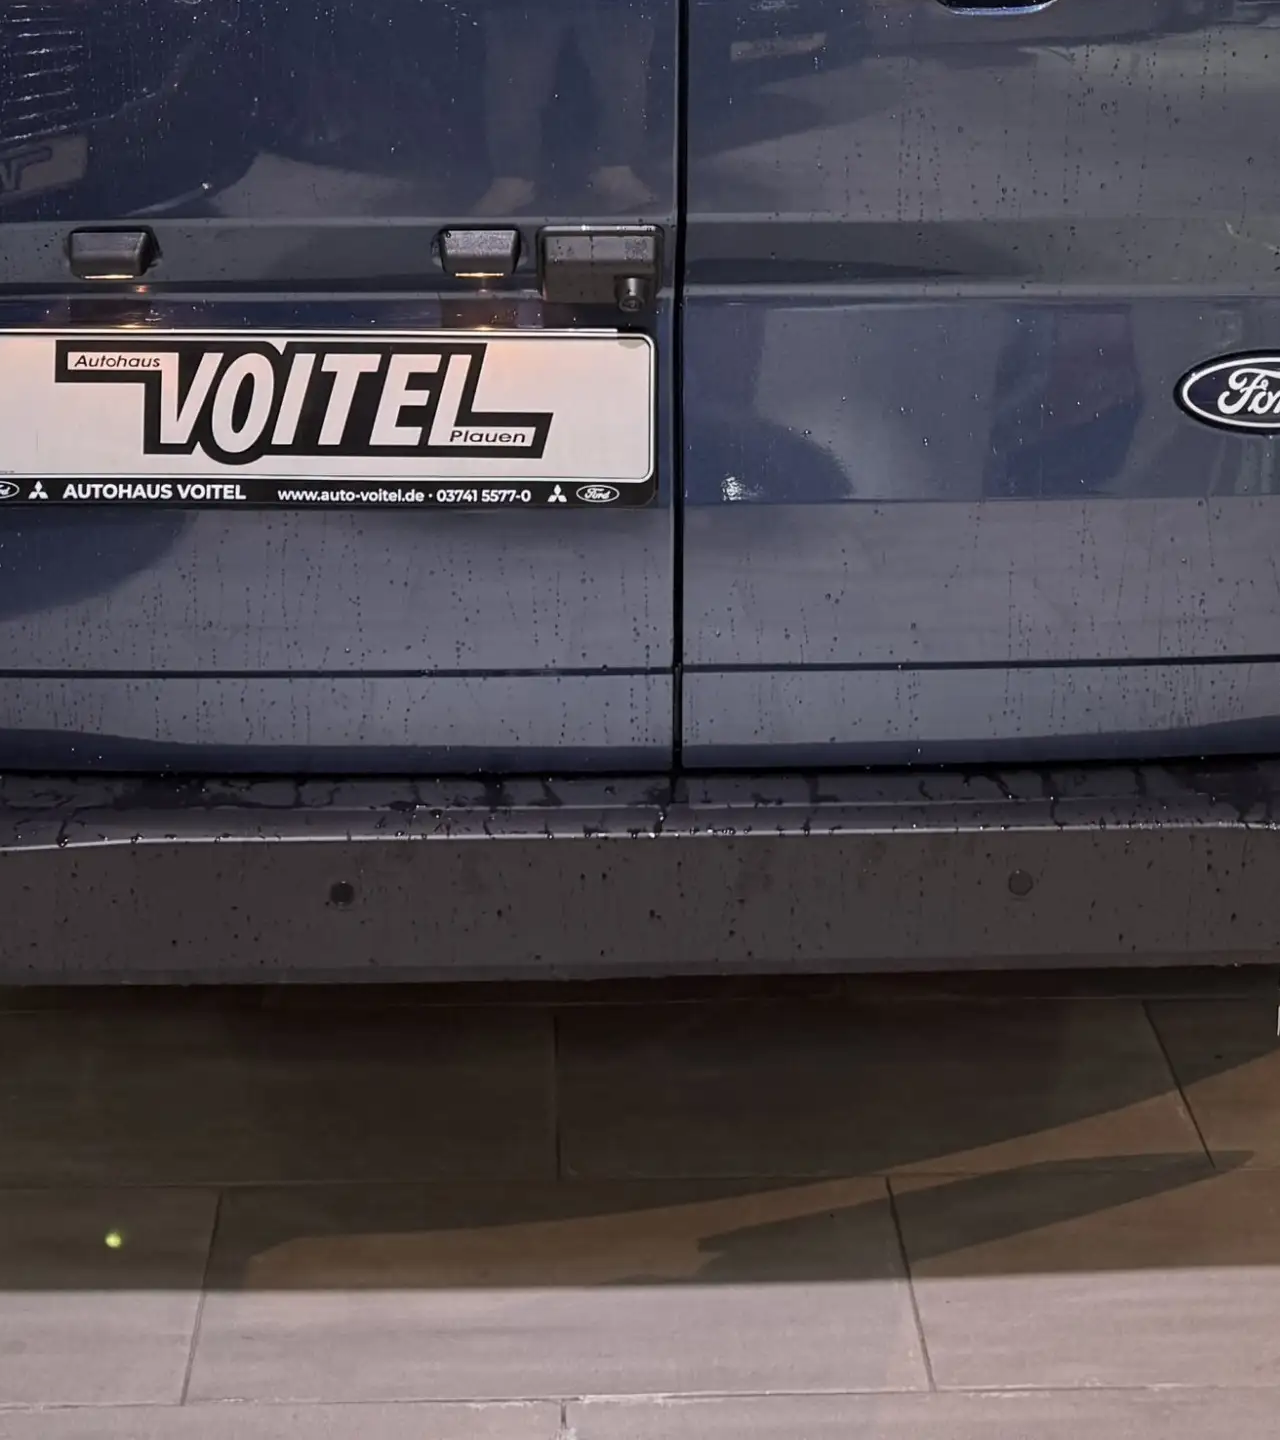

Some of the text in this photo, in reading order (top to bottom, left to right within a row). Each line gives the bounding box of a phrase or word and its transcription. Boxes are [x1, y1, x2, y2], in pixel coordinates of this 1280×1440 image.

[74, 354, 161, 368] Autohaus
[160, 351, 473, 454] VOITEL
[449, 429, 526, 444] Plauen
[62, 483, 247, 501] AUTOHAUS VOITEL
[277, 487, 532, 503] www.auto-voitel.de 03741 5577-0
